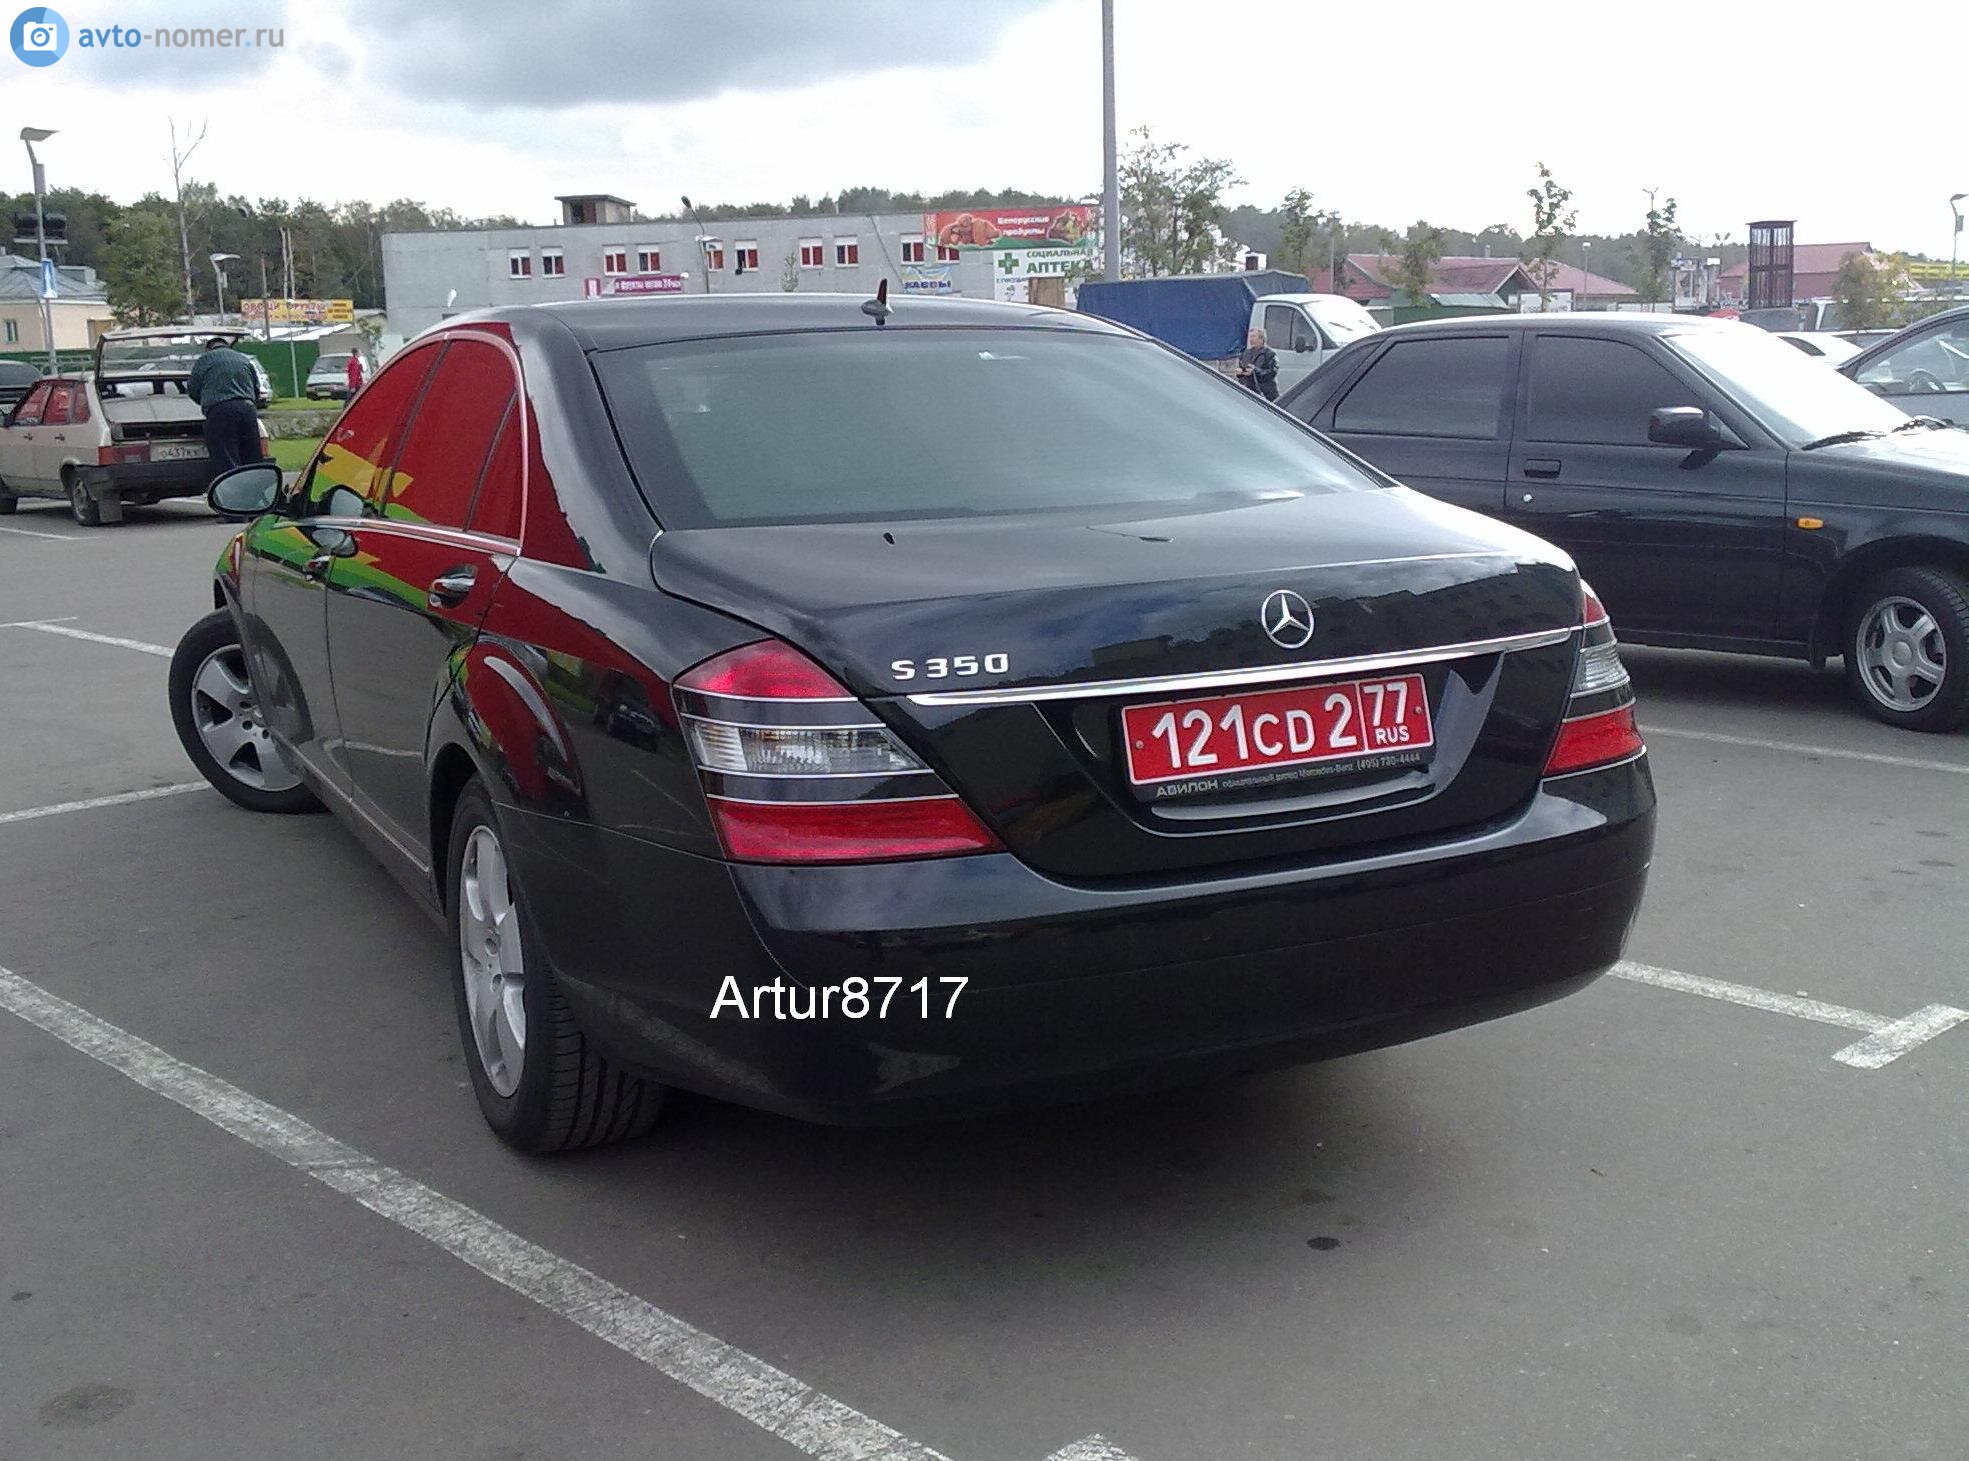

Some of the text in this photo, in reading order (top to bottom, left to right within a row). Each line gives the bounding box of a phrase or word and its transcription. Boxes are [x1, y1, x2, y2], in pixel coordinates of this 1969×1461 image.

[925, 653, 1010, 679] 350
[1364, 681, 1409, 727] 77
[1375, 725, 1411, 745] RUS
[1156, 779, 1219, 797] АВИЛОН
